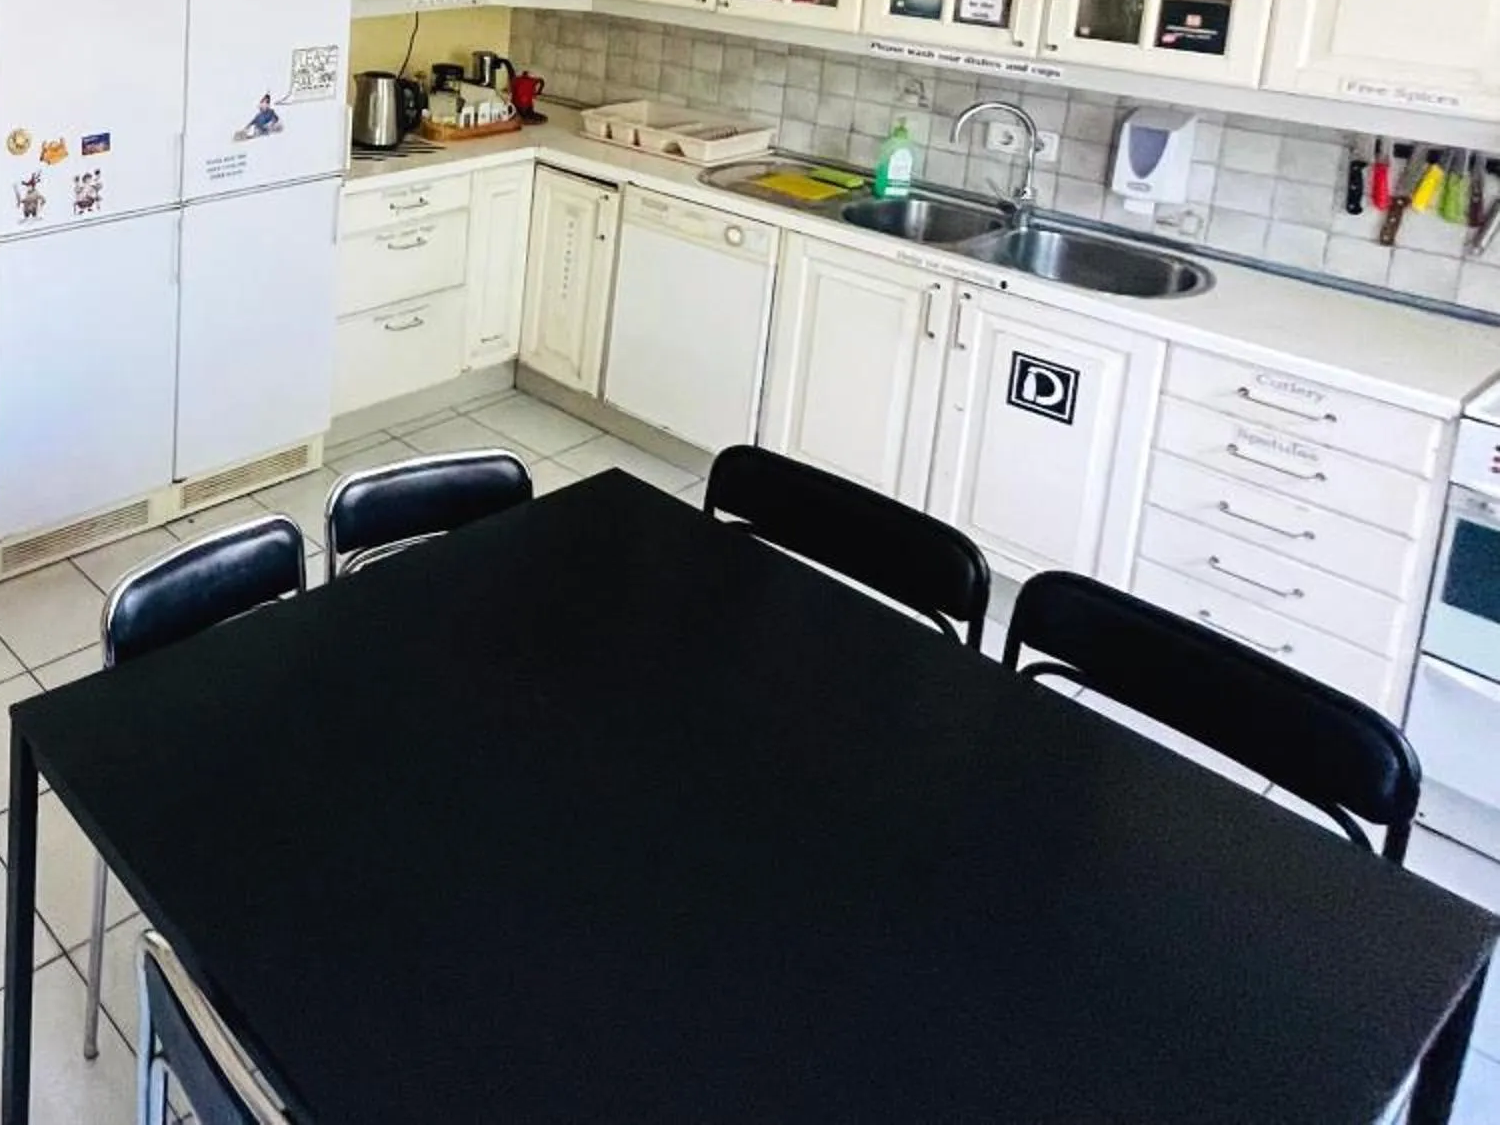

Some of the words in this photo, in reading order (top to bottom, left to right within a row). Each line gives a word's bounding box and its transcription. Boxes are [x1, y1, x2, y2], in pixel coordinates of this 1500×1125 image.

[870, 41, 905, 53] Please
[907, 47, 935, 58] wash
[963, 56, 1002, 69] dishes
[1005, 63, 1029, 72] and
[1031, 67, 1061, 78] cups
[1346, 81, 1387, 95] Free
[1394, 86, 1461, 107] Spices
[1255, 373, 1326, 404] Cutlery
